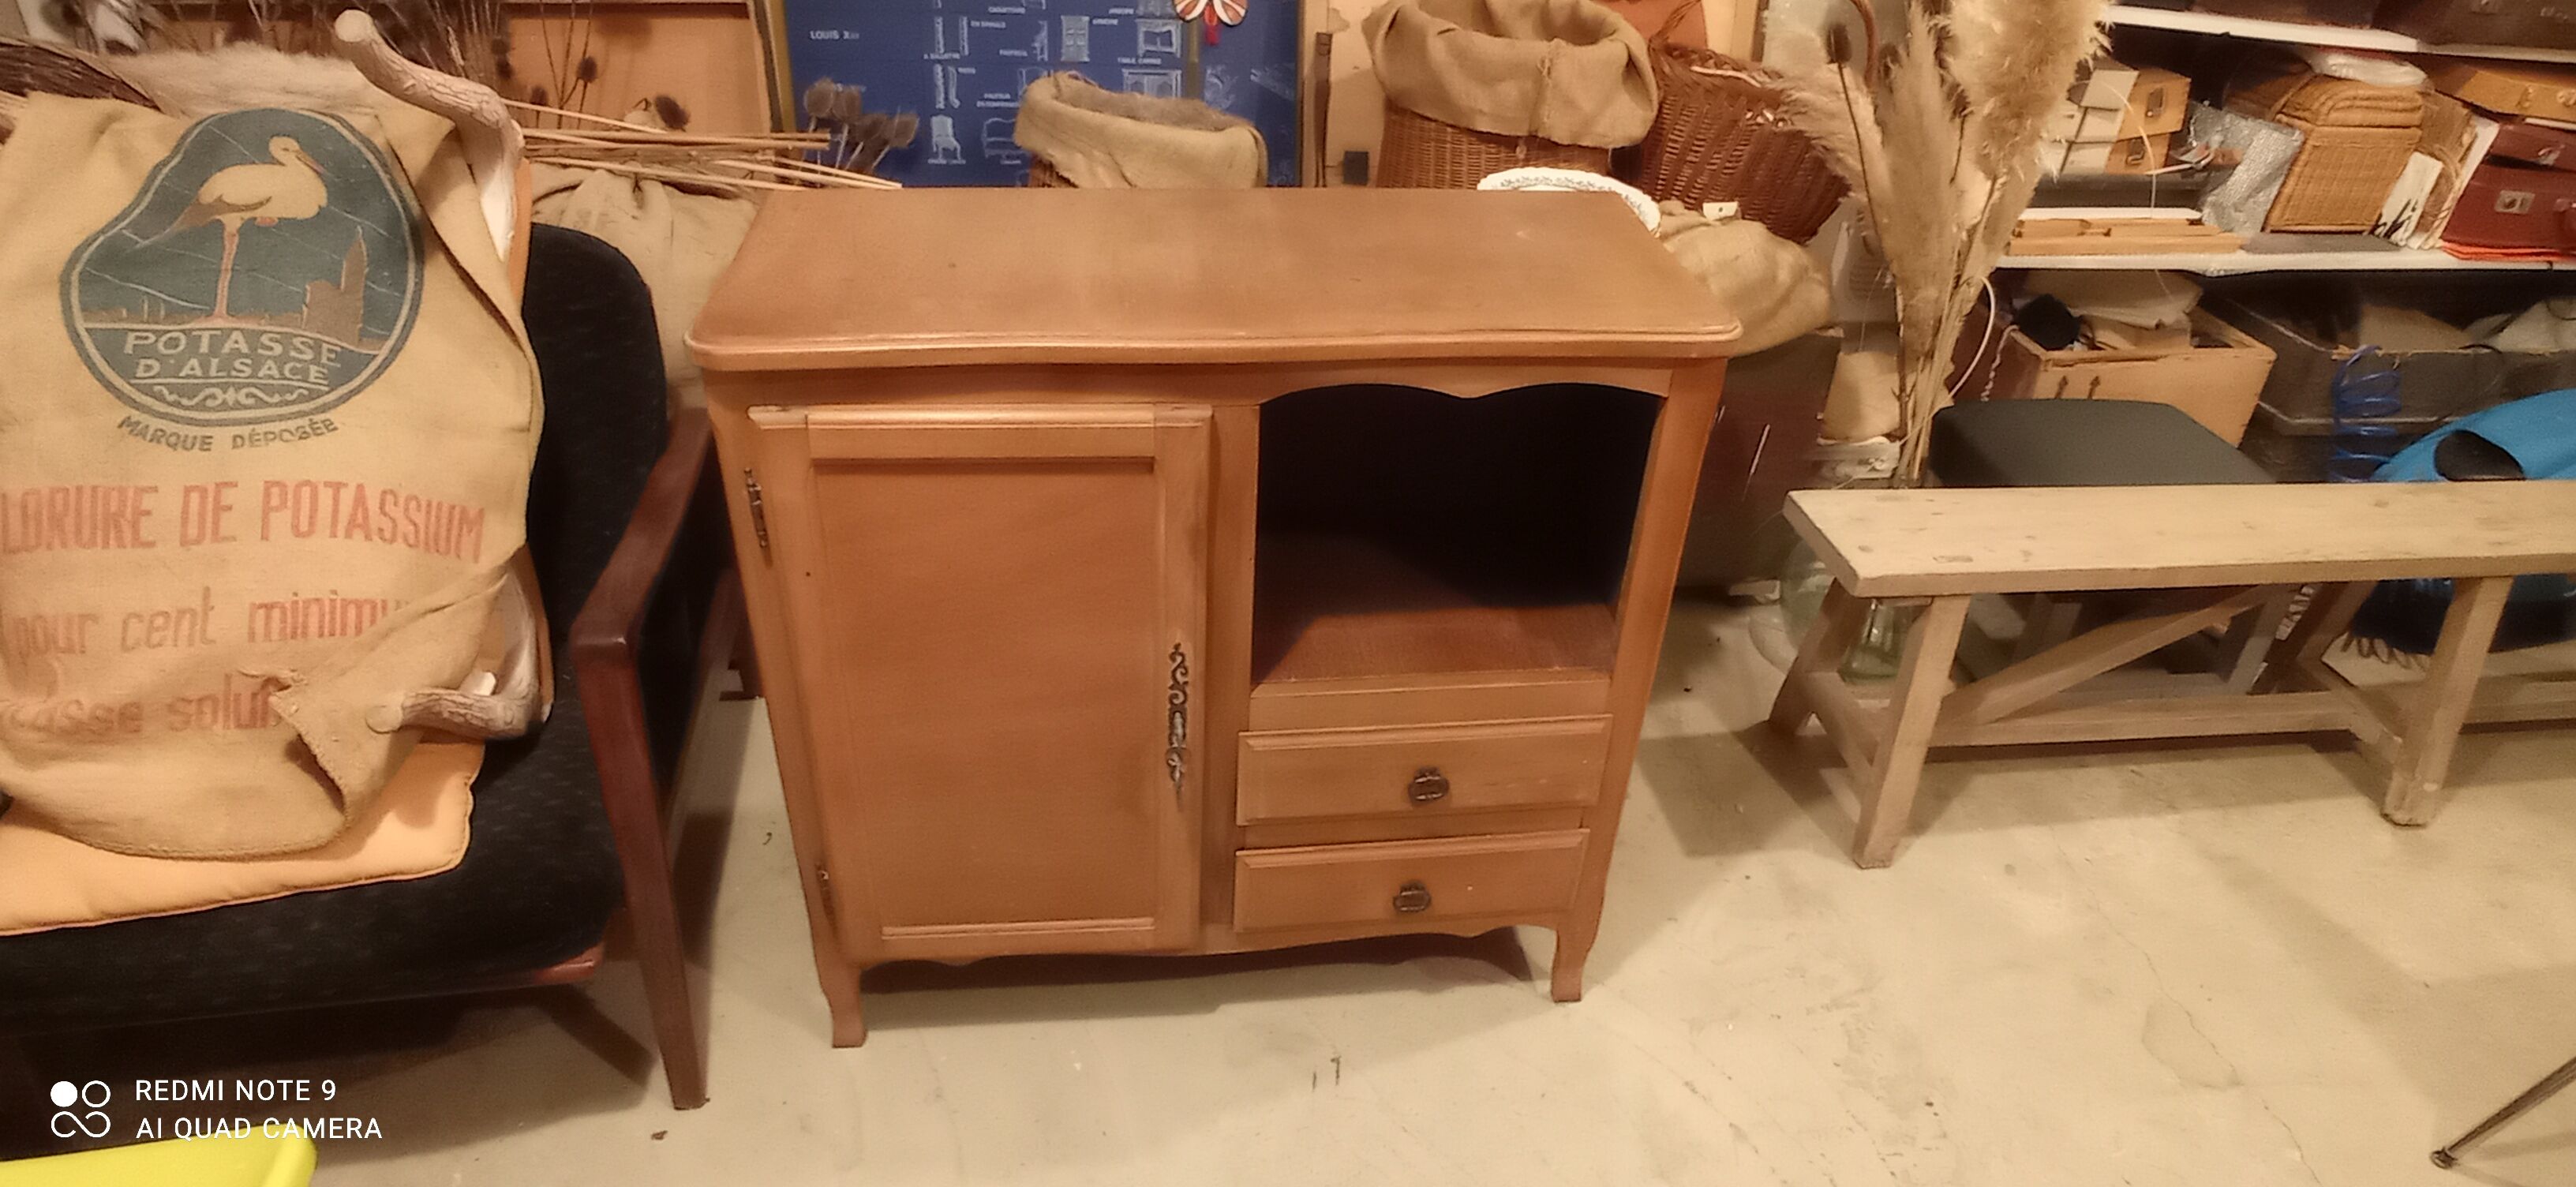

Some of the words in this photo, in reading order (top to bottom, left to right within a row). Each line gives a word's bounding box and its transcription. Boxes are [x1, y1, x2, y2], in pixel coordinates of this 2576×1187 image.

[810, 30, 839, 39] LOUIS
[124, 330, 342, 368] POTASSE
[135, 358, 330, 385] D'ALSACE
[118, 415, 213, 452] MARQUE
[231, 418, 339, 450] DÉPOSÉE
[179, 481, 238, 547] DE
[260, 479, 485, 564] POTASSIUM
[121, 586, 216, 653] cent
[247, 589, 395, 644] minim
